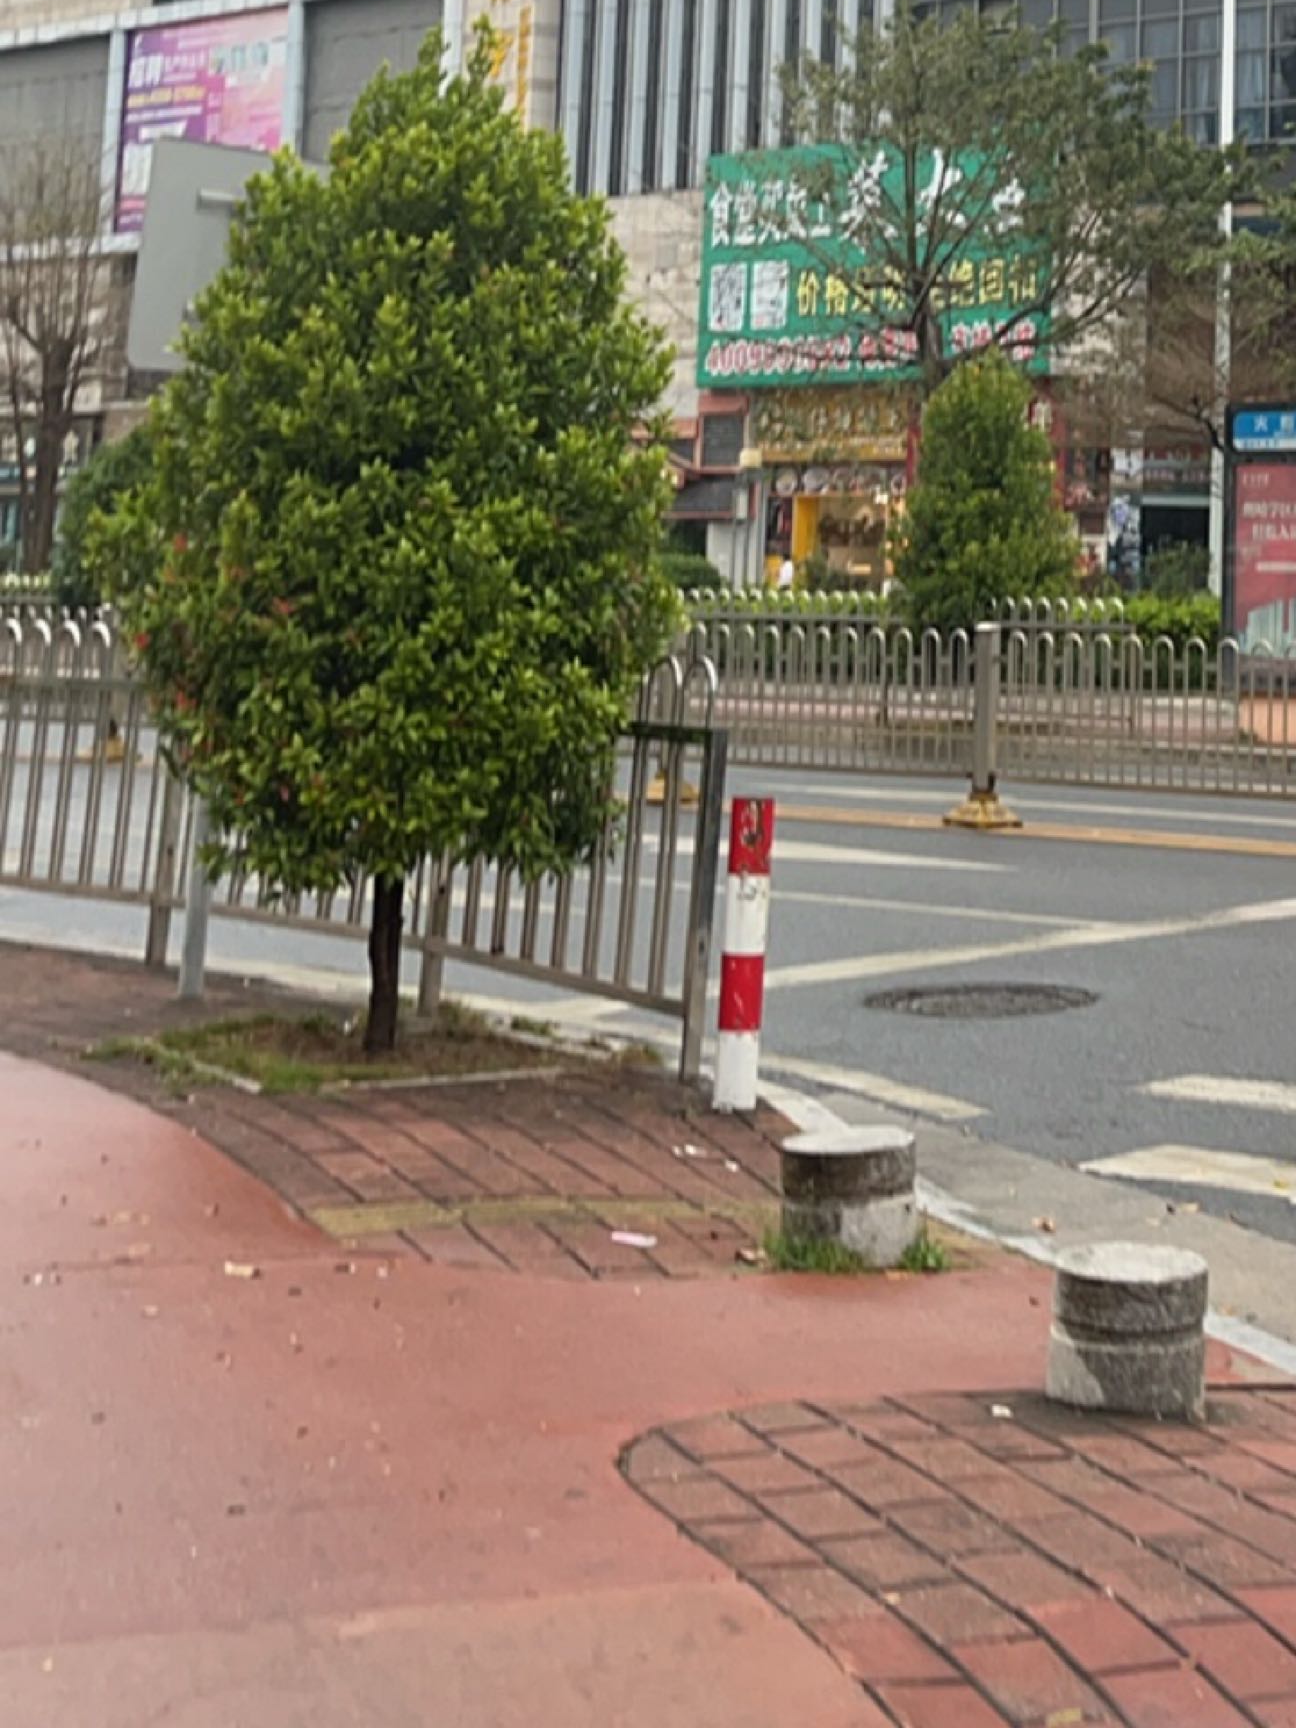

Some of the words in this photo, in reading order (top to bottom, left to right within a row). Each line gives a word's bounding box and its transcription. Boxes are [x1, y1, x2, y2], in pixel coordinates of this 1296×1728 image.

[796, 256, 1039, 318] 价格绝回扣
